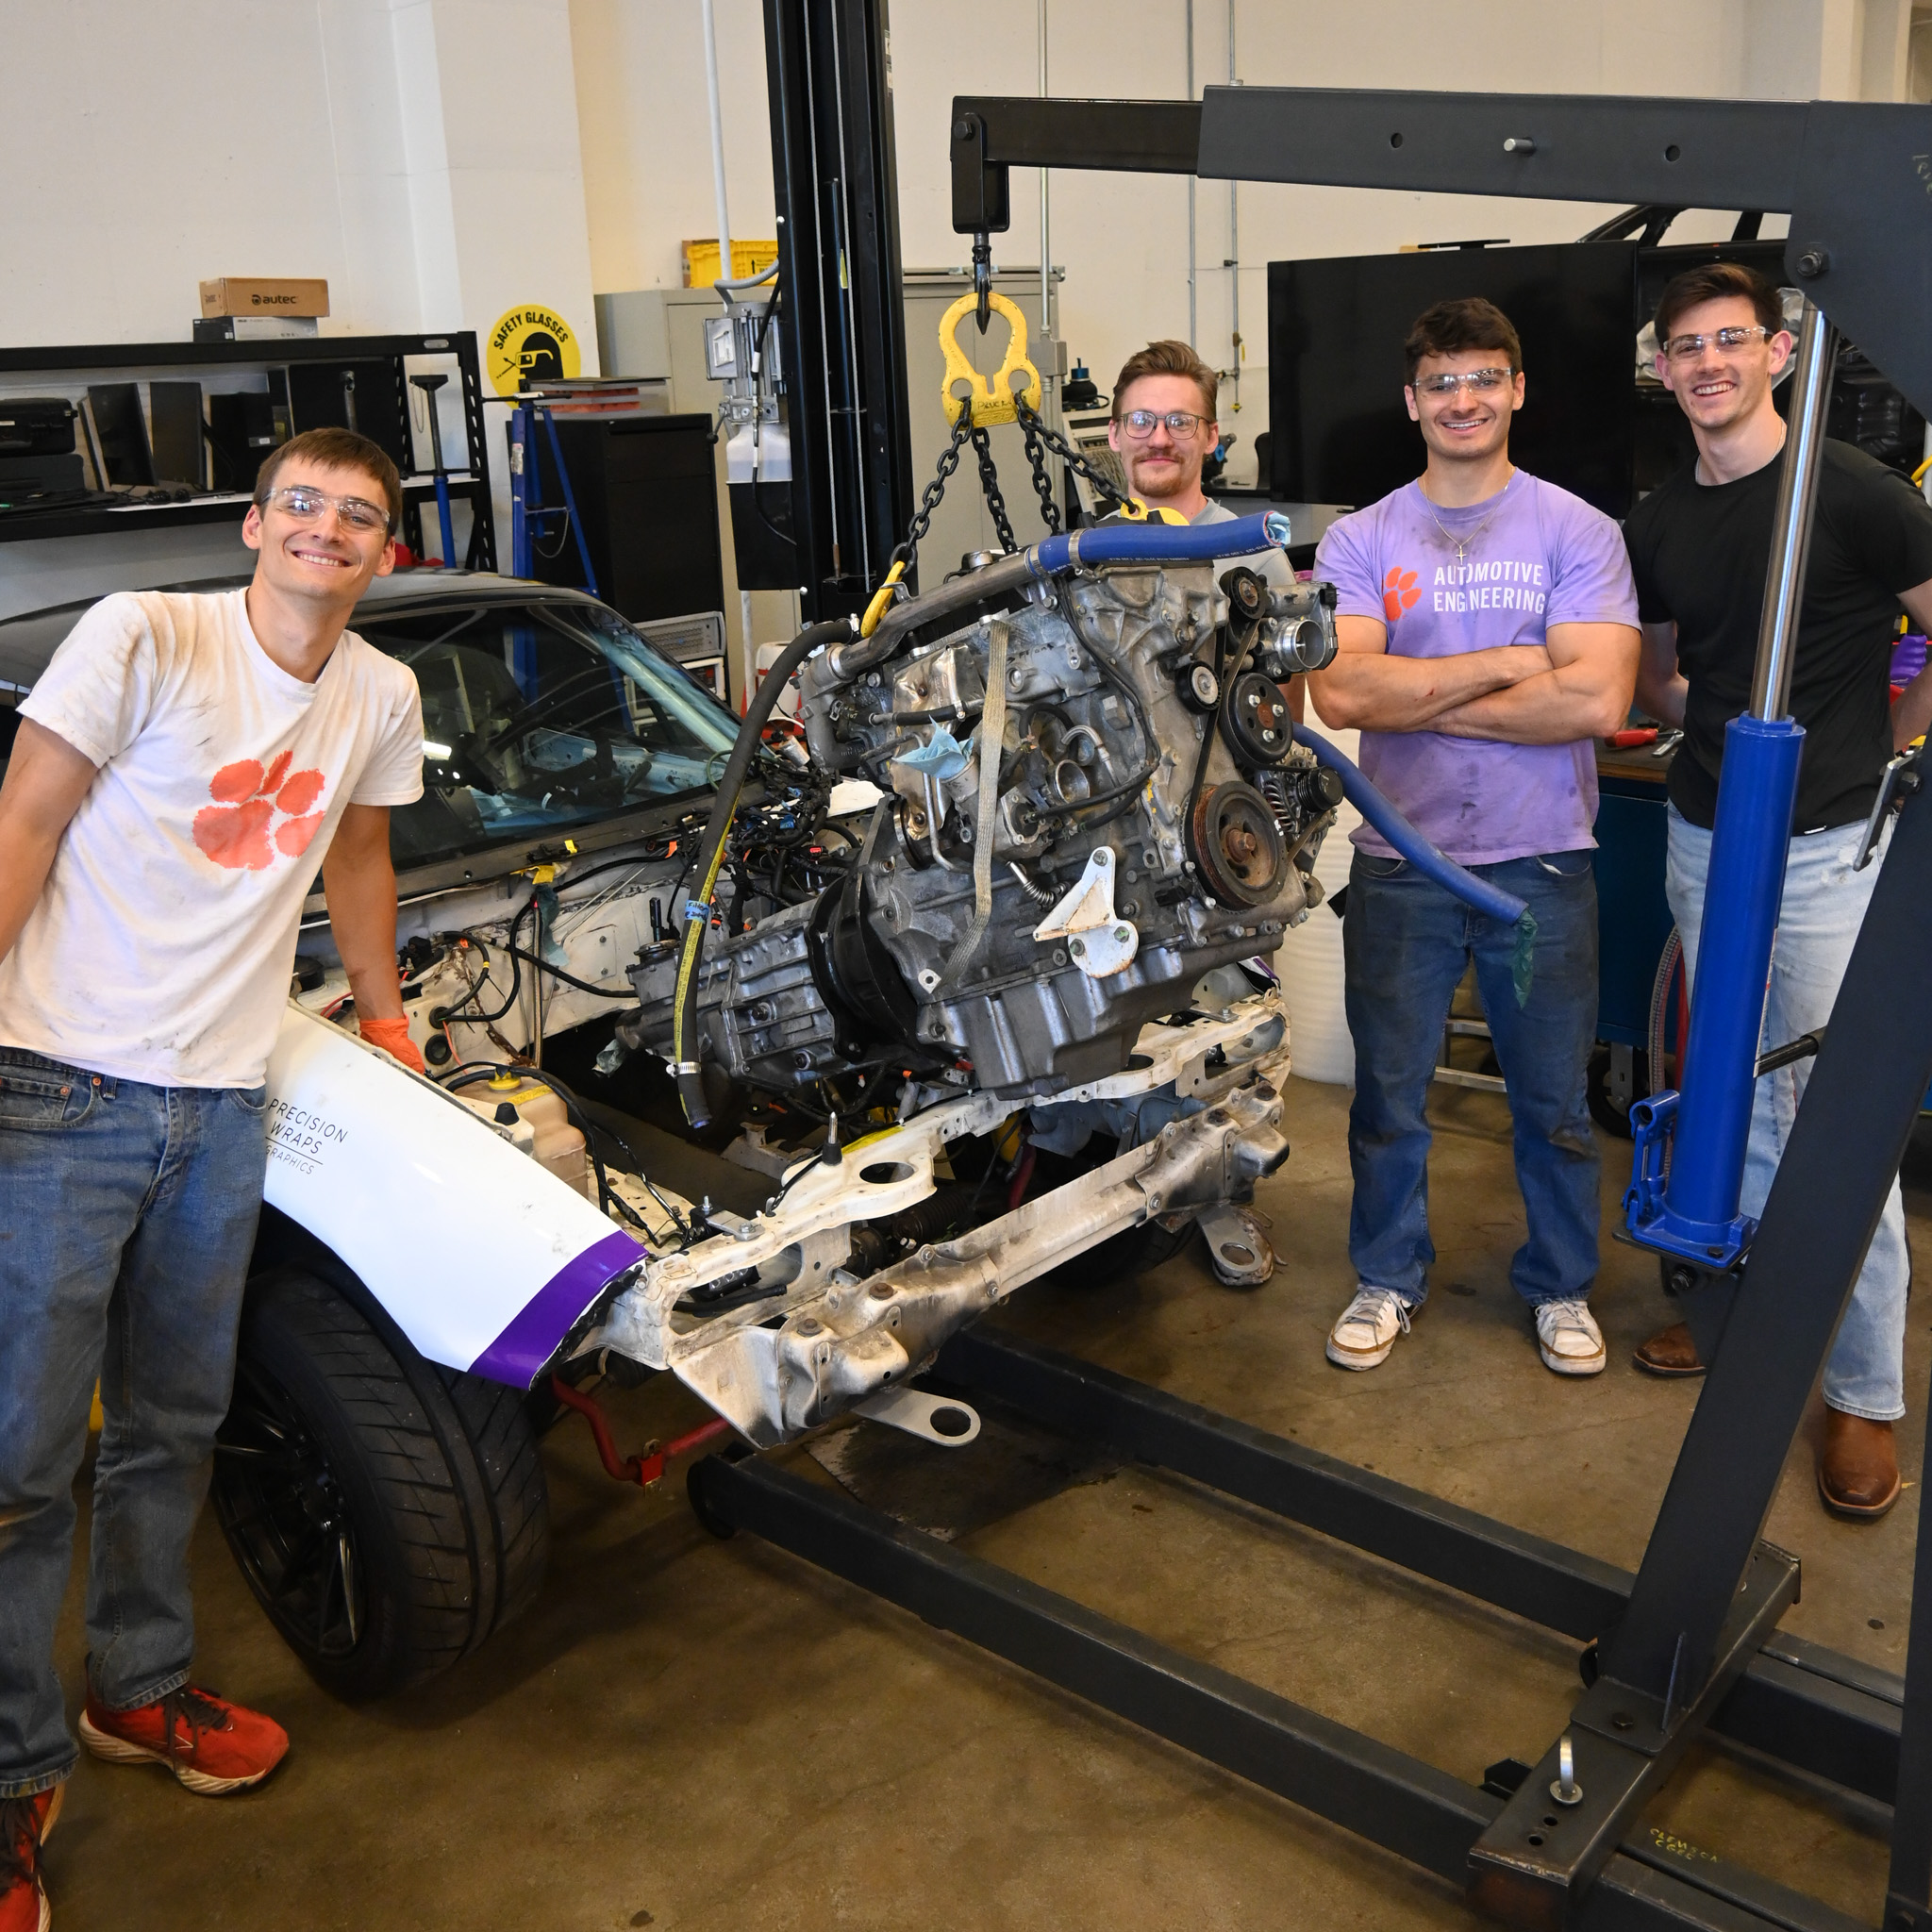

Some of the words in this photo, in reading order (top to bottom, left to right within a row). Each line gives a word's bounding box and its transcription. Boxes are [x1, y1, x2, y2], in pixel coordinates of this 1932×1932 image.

[262, 295, 297, 304] autec
[493, 313, 523, 350] SAFETY
[525, 311, 569, 342] GLASSES
[268, 1098, 348, 1143] PRECISION
[270, 1121, 323, 1154] WRAPS
[265, 1144, 314, 1174] GRAPHICS
